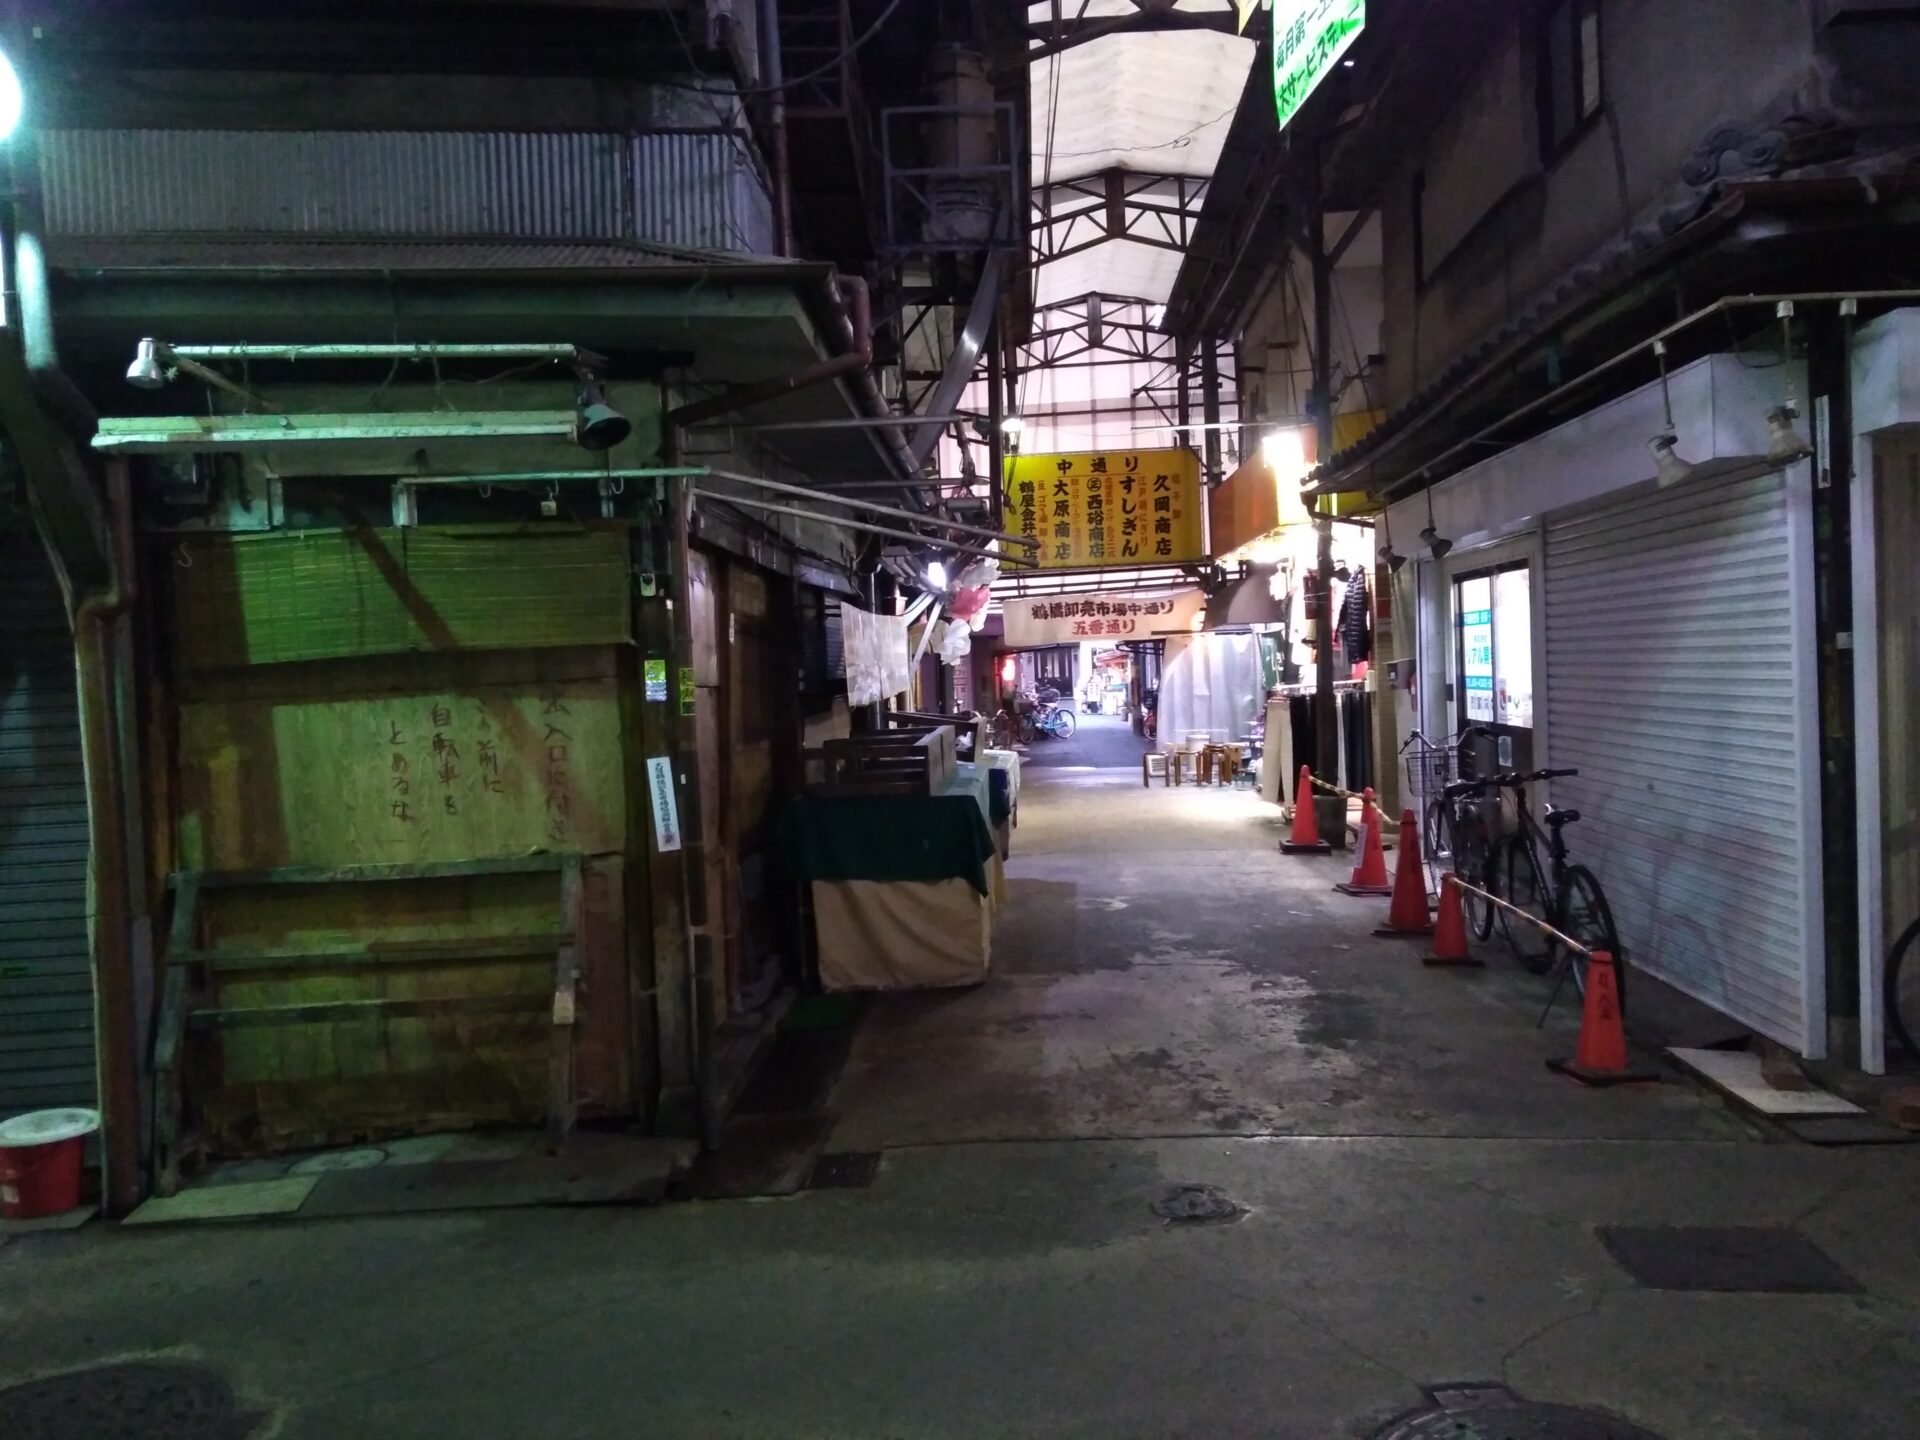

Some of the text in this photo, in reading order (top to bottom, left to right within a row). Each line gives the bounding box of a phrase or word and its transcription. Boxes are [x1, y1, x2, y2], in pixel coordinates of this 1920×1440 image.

[1056, 456, 1140, 475] 中通り
[1053, 479, 1072, 560] 大原商店
[1119, 475, 1139, 558] すしぎん
[1031, 599, 1175, 620] 鶴橋卸売市場中通り
[1072, 619, 1136, 635] 五番通り
[388, 720, 416, 822] とめるな
[431, 702, 461, 816] 自転車を
